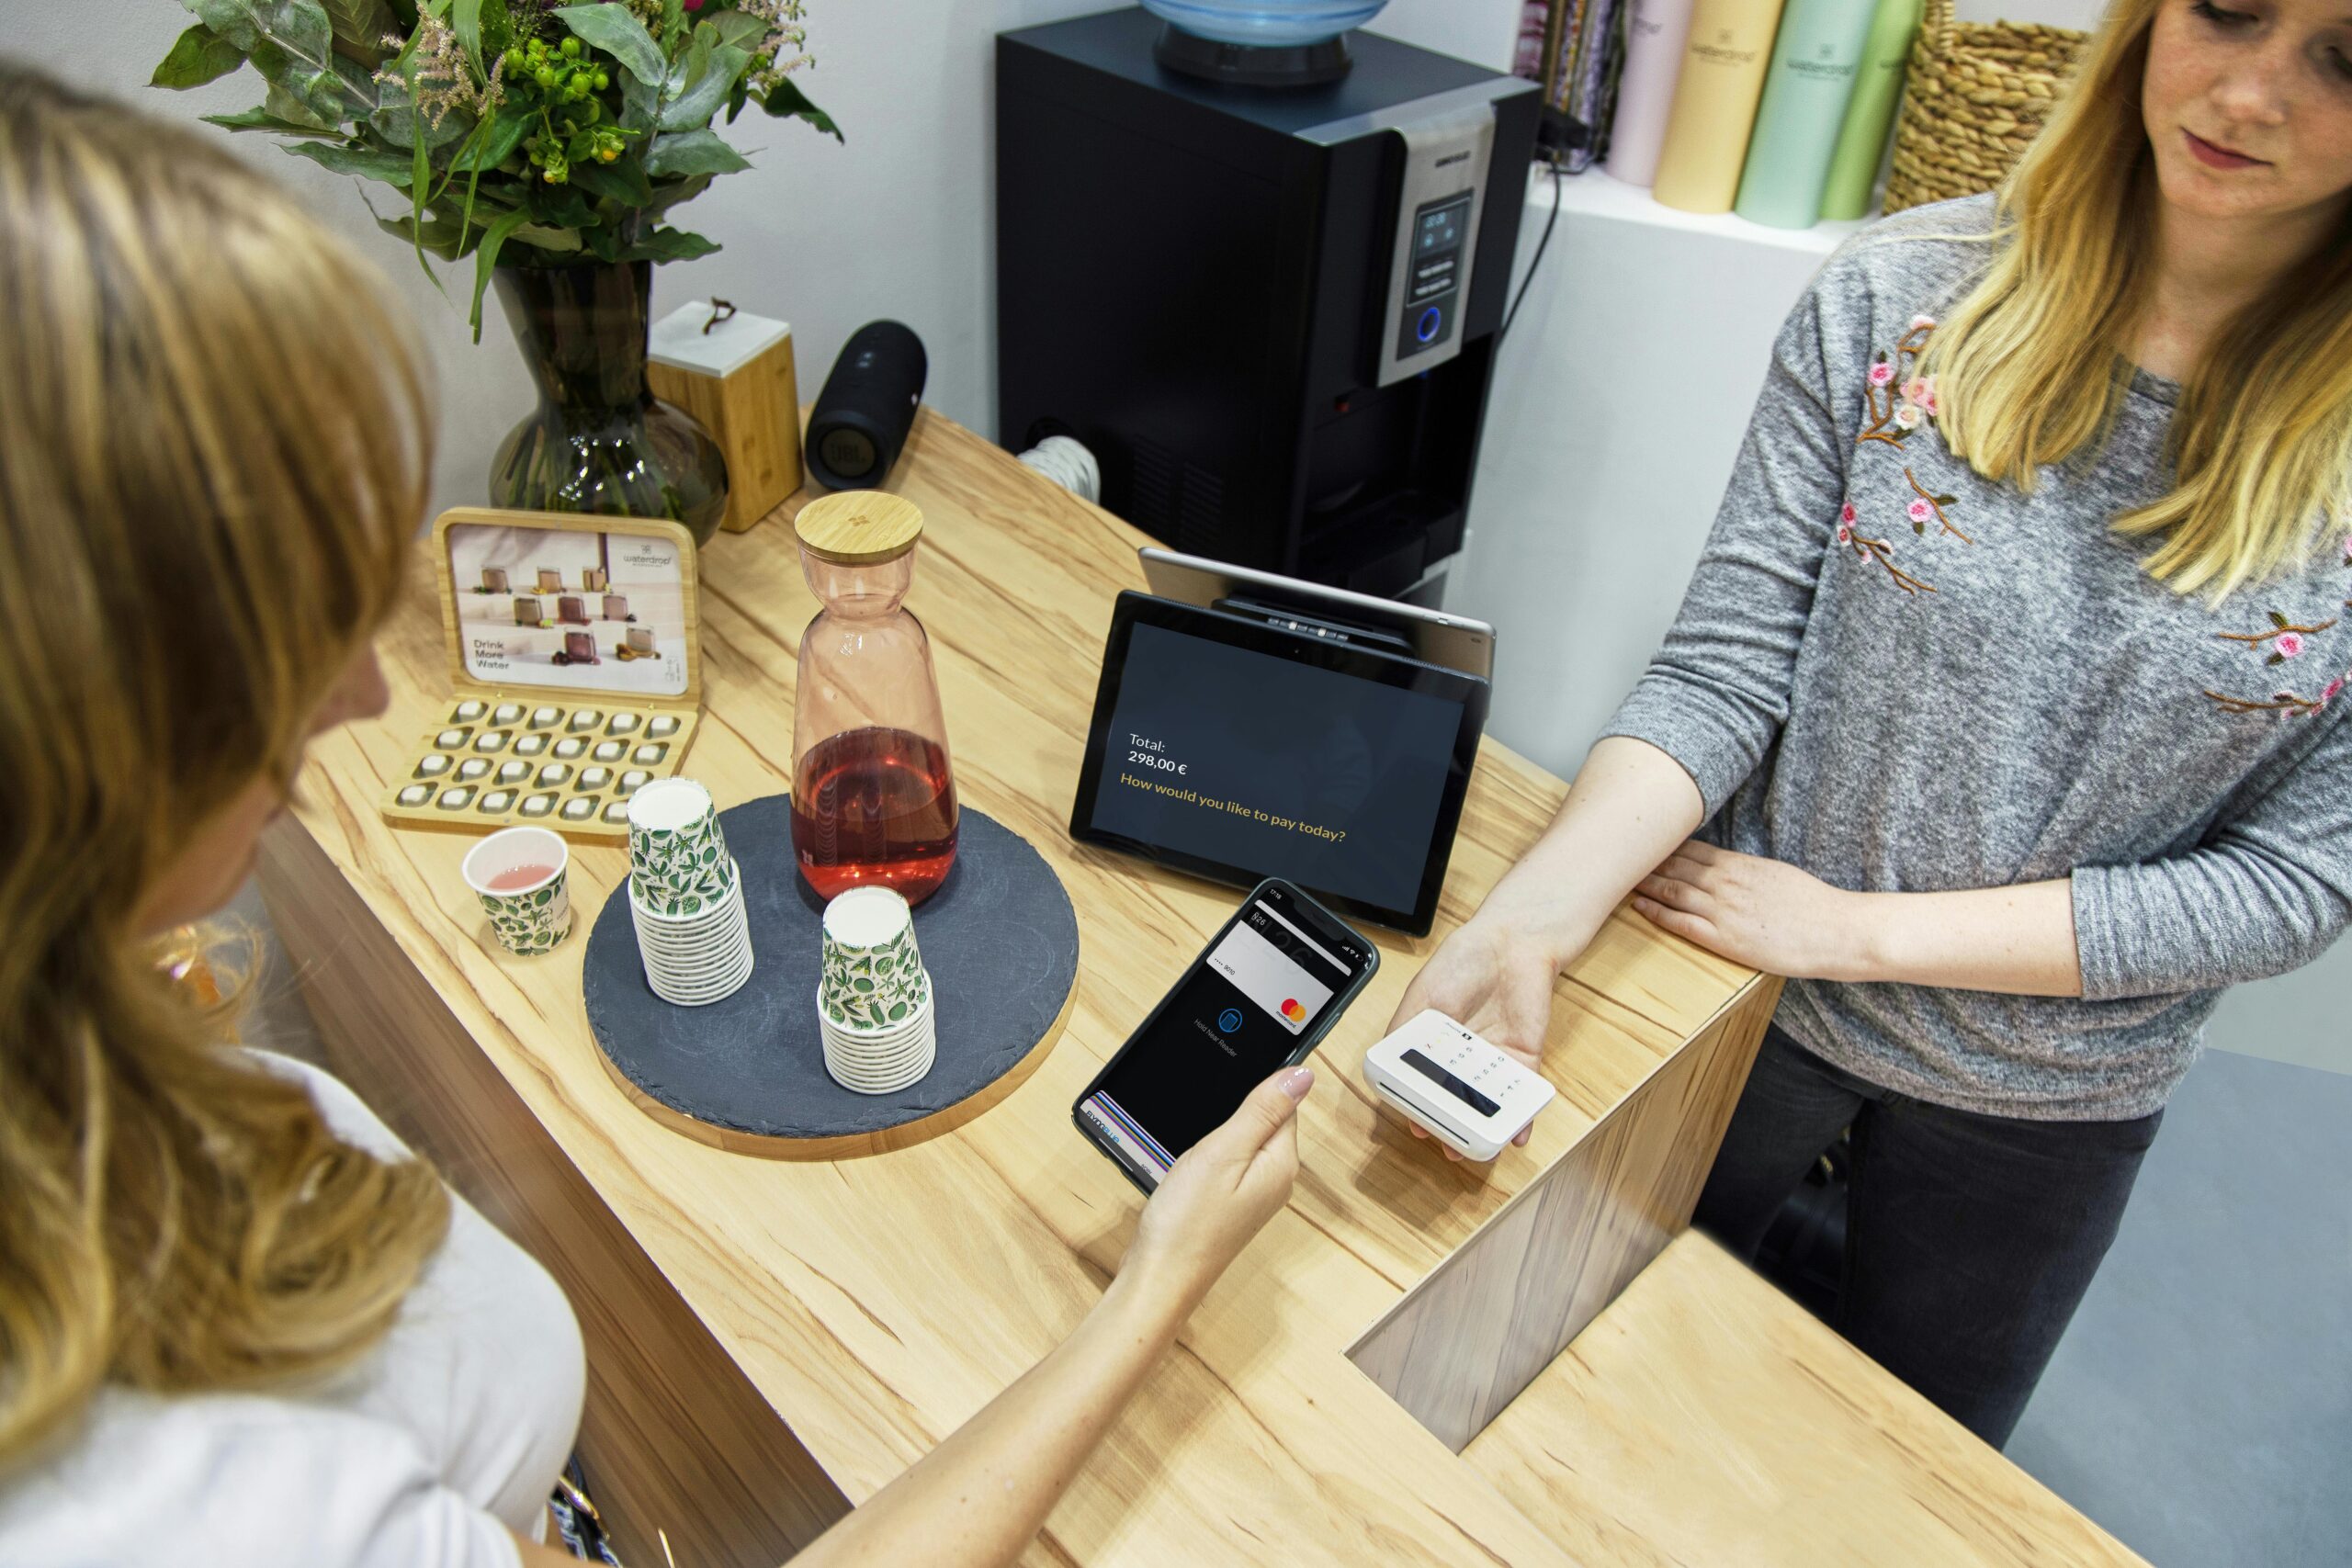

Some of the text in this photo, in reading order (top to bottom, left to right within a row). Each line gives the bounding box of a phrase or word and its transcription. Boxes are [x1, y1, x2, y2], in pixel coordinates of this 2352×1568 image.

[624, 554, 672, 565] waterdrop
[473, 639, 503, 649] Drink
[475, 649, 503, 660] More
[477, 660, 509, 669] Water
[1129, 733, 1165, 753] Total:
[1128, 750, 1188, 775] 298,00 €
[1120, 773, 1346, 842] How would you like to pay today?
[1275, 1010, 1297, 1029] mastercard
[1193, 1018, 1238, 1057] Hold Near Reader
